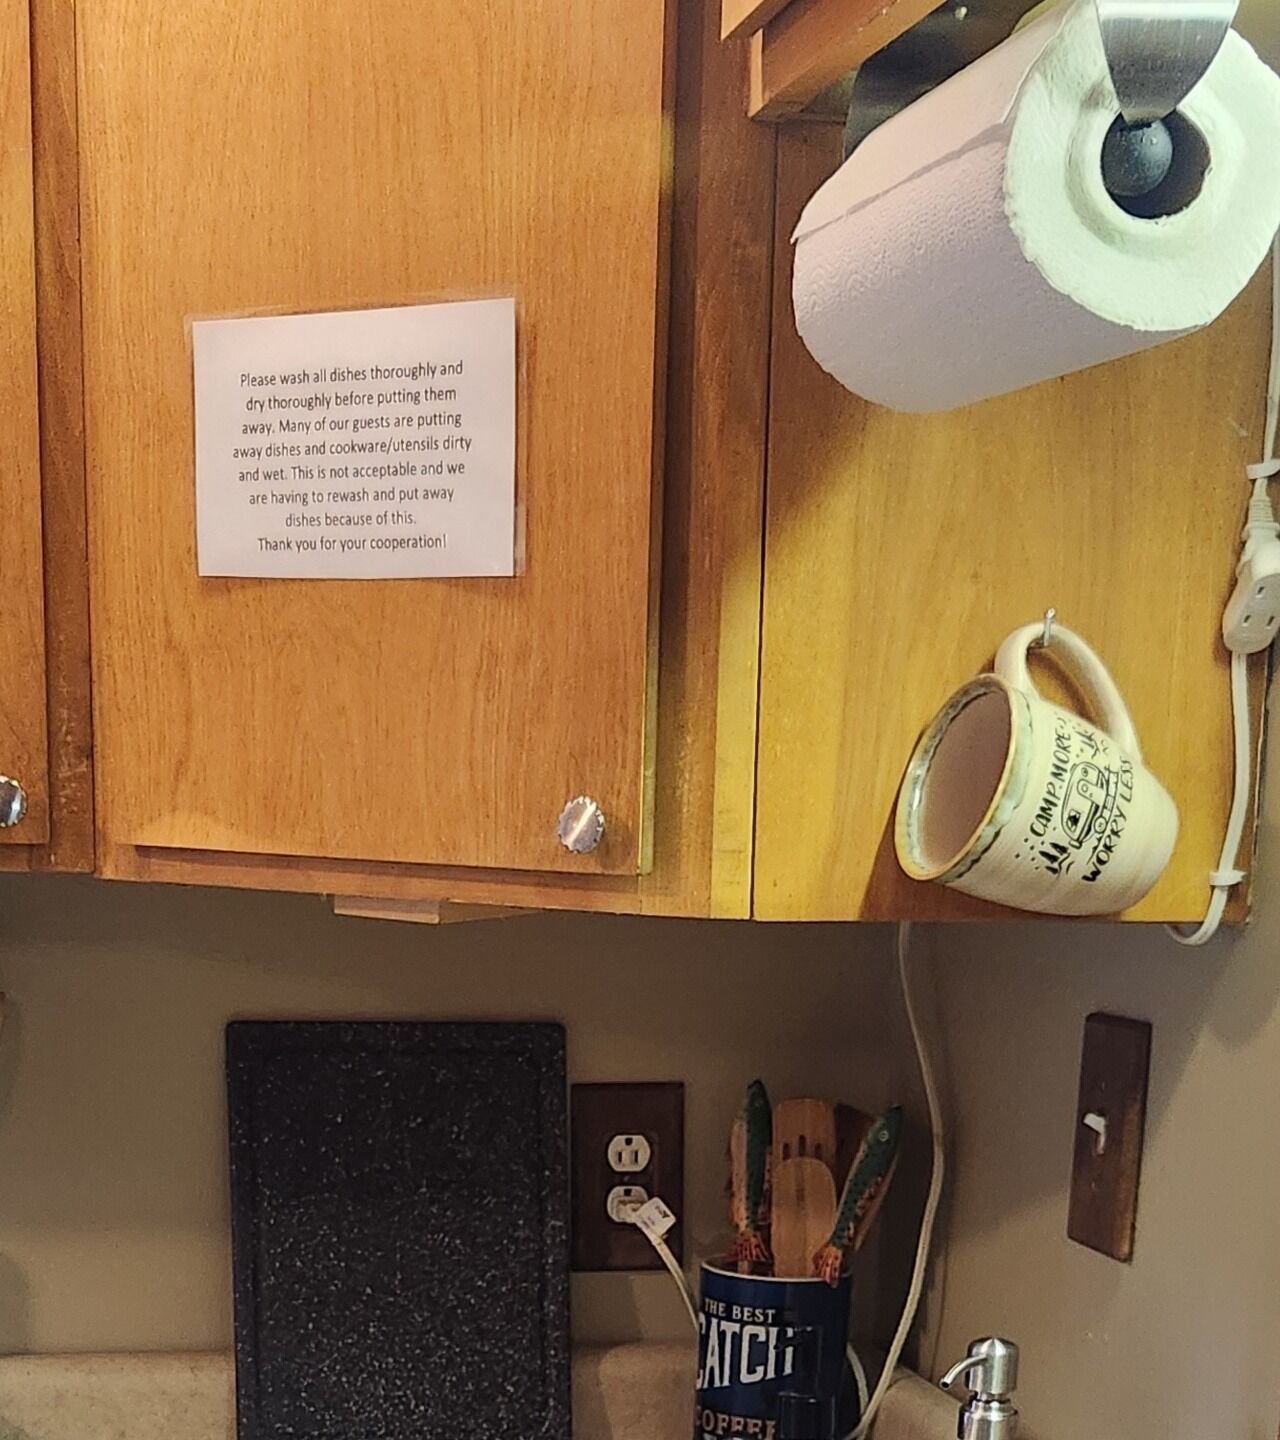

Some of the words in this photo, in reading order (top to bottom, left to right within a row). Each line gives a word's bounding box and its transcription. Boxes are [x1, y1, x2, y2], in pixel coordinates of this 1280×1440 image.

[240, 372, 276, 387] Please
[278, 368, 310, 385] wash
[312, 367, 326, 383] all
[329, 366, 367, 382] dishes
[369, 360, 437, 381] thoroughly
[439, 358, 463, 376] and
[245, 396, 265, 413] dry
[267, 391, 332, 411] thoroughly
[334, 389, 374, 406] before
[376, 387, 420, 407] putting
[423, 385, 456, 402] them
[241, 422, 275, 436] away.
[278, 418, 312, 435] Many
[313, 415, 326, 431] of
[328, 418, 350, 431] our
[351, 415, 390, 433] guests
[392, 415, 414, 428] are
[416, 410, 462, 430] putting
[232, 446, 263, 461] away
[264, 441, 301, 457] dishes
[304, 439, 326, 456] and
[328, 434, 439, 455] cookware/utensils
[442, 434, 472, 452] dirty
[238, 466, 259, 482] and
[261, 467, 288, 481] wet.
[290, 464, 314, 480] This
[316, 464, 326, 479] is
[329, 464, 349, 479] not
[352, 460, 417, 480] acceptable
[420, 459, 443, 475] and
[446, 462, 465, 475] we
[248, 493, 268, 505] are
[270, 489, 308, 507] having
[311, 490, 324, 503] to
[326, 486, 369, 503] rewash
[372, 485, 395, 501] and
[398, 486, 419, 504] put
[421, 487, 454, 503] away
[284, 511, 322, 527] dishes
[324, 511, 372, 526] because
[375, 509, 388, 525] of
[390, 509, 416, 525] this.
[256, 535, 292, 551] Thank
[294, 539, 316, 553] you
[319, 534, 336, 550] for
[338, 538, 366, 553] your
[1030, 782, 1061, 837] CAMP
[1051, 727, 1070, 782] MORE
[1081, 805, 1127, 882] WORRY
[1119, 756, 1135, 803] LESS
[704, 1298, 727, 1317] THE
[732, 1305, 776, 1324] BEST
[696, 1405, 776, 1440] OFFEE
